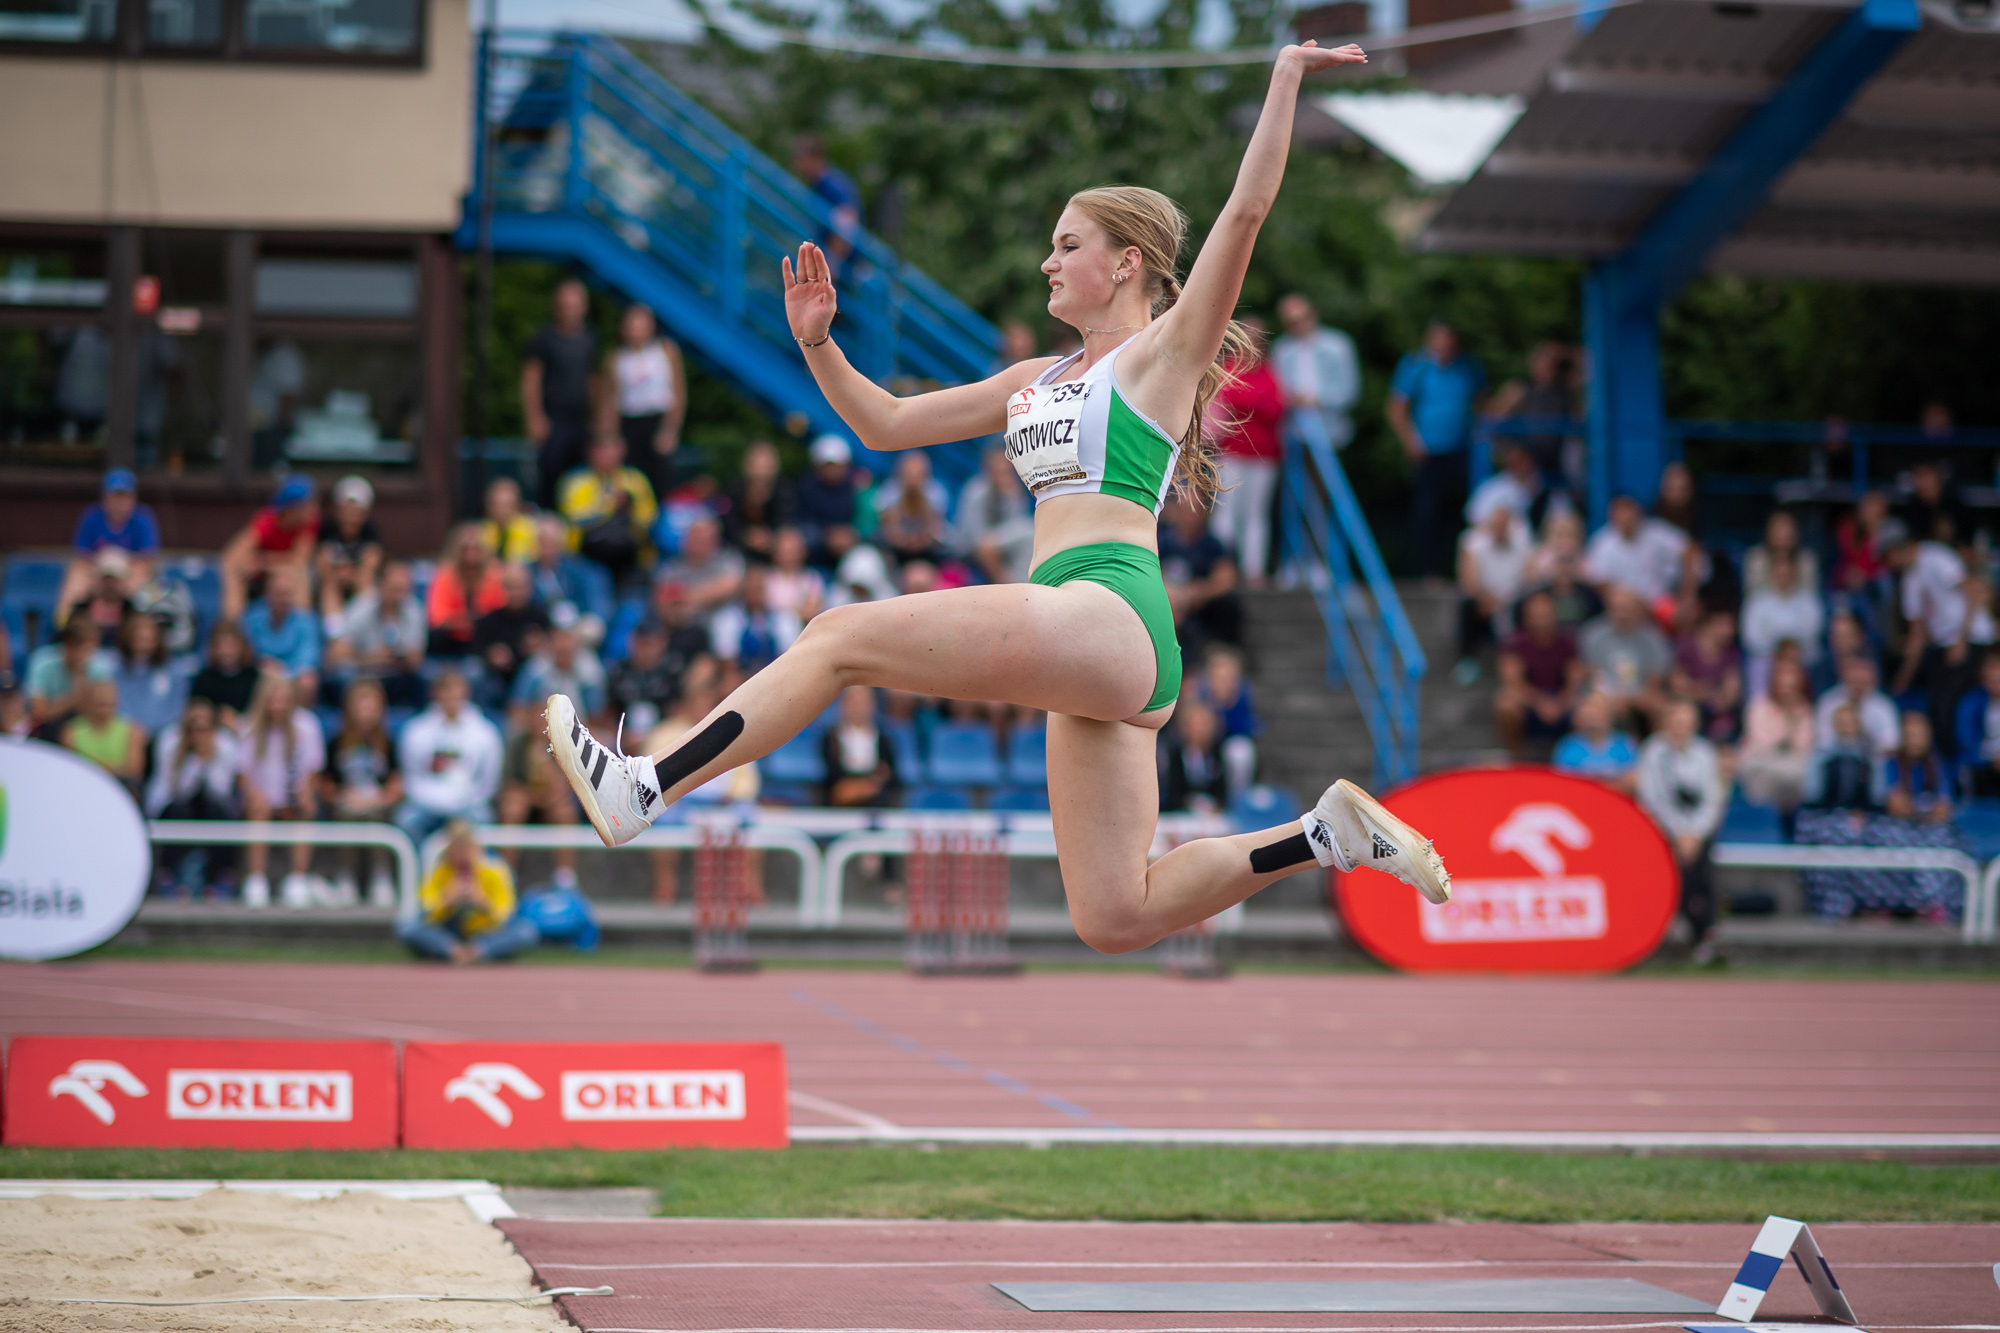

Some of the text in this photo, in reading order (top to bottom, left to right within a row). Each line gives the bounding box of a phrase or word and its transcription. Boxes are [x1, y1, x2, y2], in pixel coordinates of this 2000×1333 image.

[636, 780, 649, 816] adidas
[1316, 820, 1332, 851] didas
[1372, 833, 1398, 855] adidas
[182, 1081, 337, 1109] ORLEN
[577, 1082, 728, 1109] ORLEN
